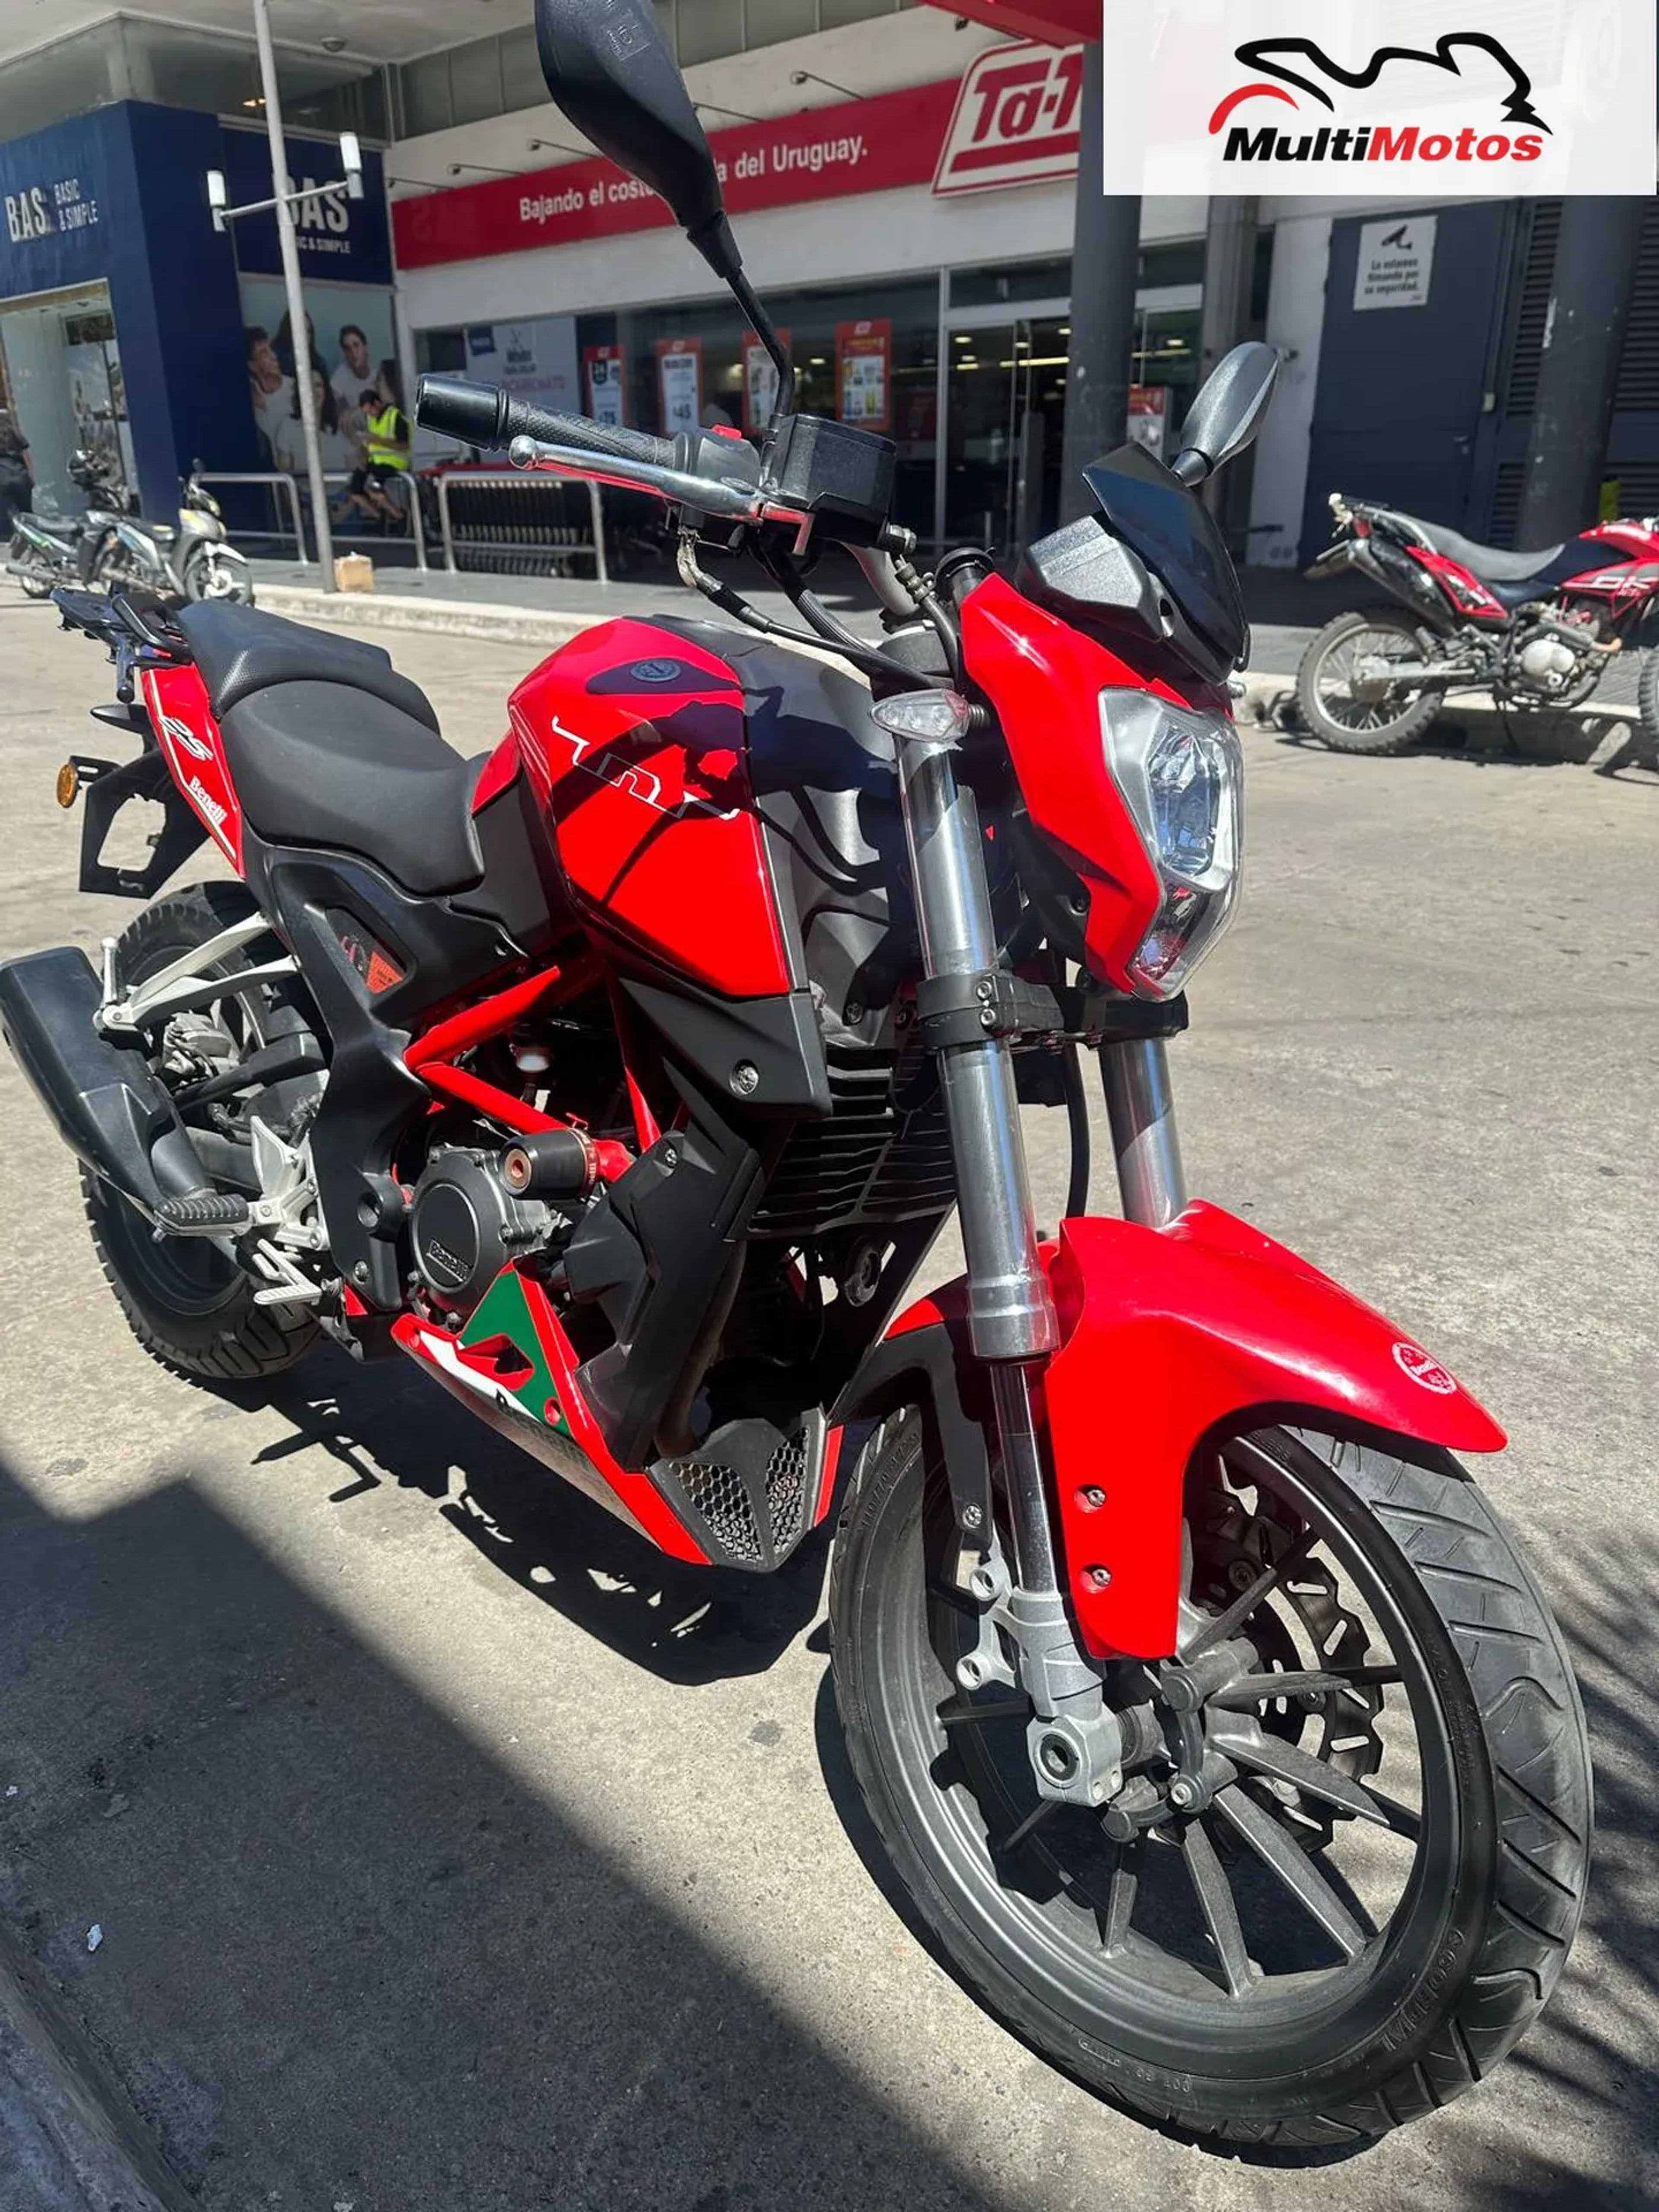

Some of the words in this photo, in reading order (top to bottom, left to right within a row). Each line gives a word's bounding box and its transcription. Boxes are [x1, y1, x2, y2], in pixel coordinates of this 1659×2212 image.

[54, 178, 80, 206] BASIC
[519, 188, 584, 225] Bajando
[589, 181, 604, 207] el
[735, 140, 764, 179] del
[773, 134, 868, 172] Uruguay.
[4, 187, 46, 242] BAS
[65, 200, 98, 230] SIMPLE
[188, 775, 228, 825] Benelli
